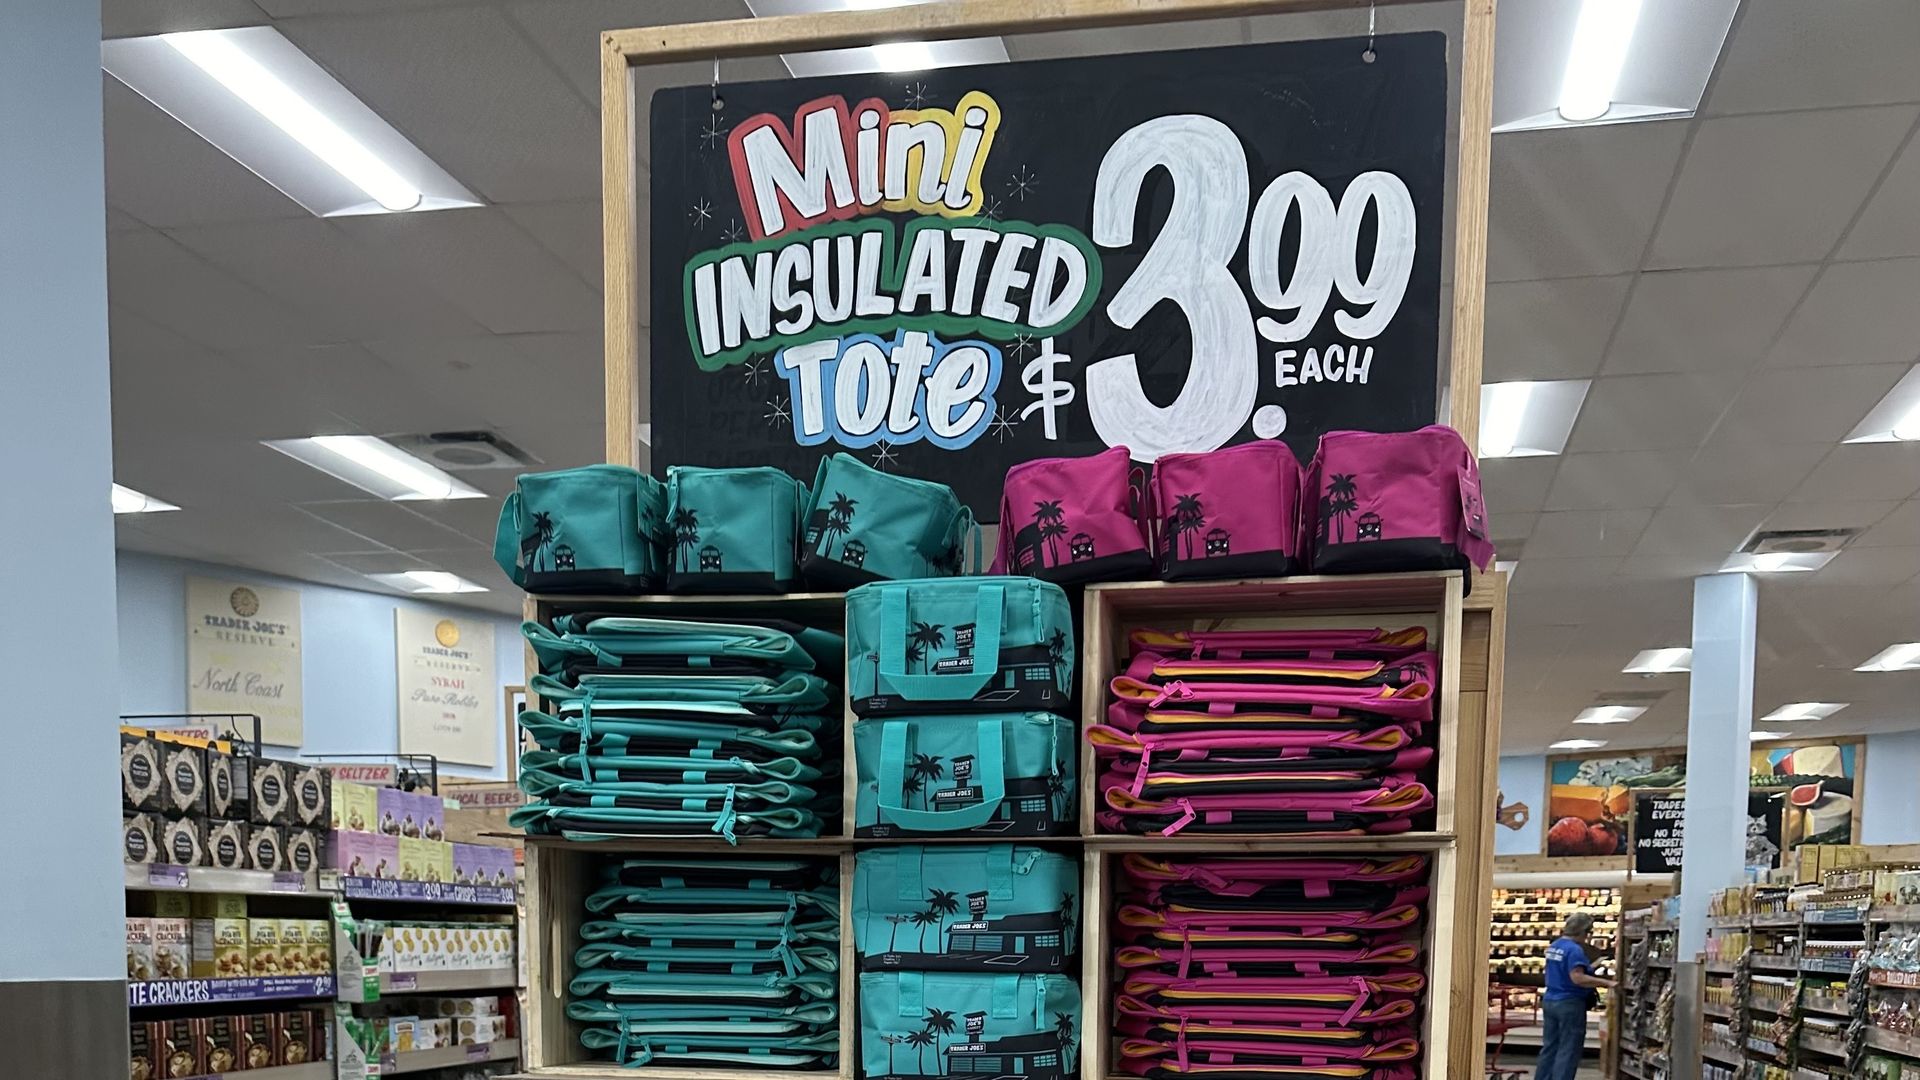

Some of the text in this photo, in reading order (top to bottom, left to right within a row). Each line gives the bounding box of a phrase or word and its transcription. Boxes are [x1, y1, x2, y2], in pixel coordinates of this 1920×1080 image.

[742, 106, 988, 236] Mini
[693, 228, 1090, 356] INSULATED
[1274, 346, 1374, 386] EACH
[783, 330, 992, 438] Tote
[204, 614, 251, 631] TRADER
[192, 668, 284, 698] North Coast
[431, 676, 465, 690] SYRAH
[338, 766, 390, 780] SELTZER
[483, 791, 520, 805] BEERS
[1638, 838, 1651, 848] NO
[1654, 829, 1669, 838] NO
[150, 979, 209, 1004] CRACKERS
